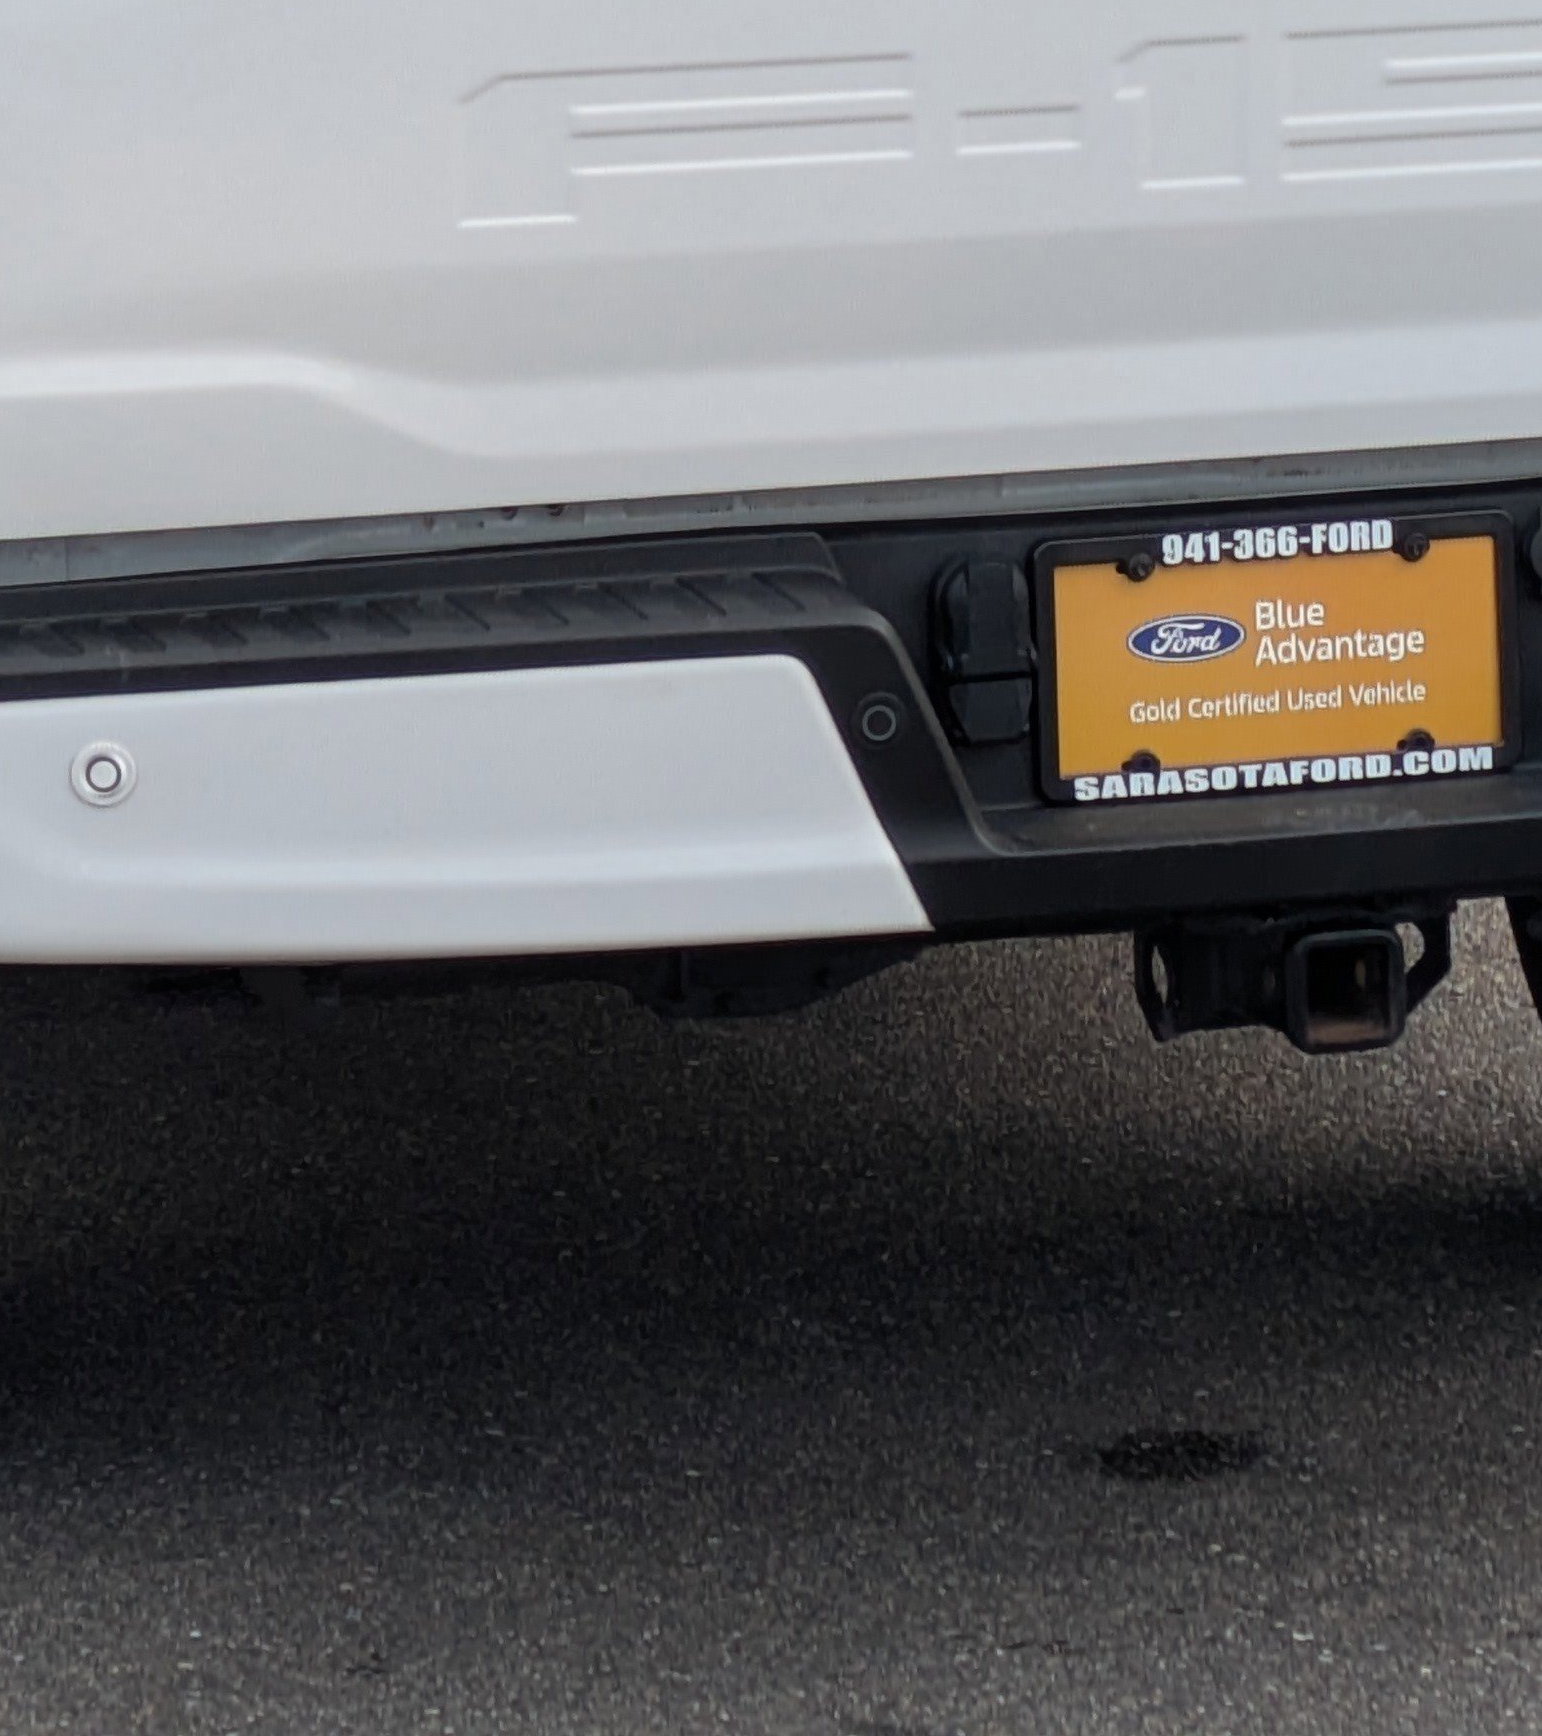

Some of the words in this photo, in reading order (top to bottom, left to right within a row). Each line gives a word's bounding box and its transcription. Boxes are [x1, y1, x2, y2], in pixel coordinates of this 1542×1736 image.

[1161, 519, 1394, 565] 941-366-FORD
[1255, 599, 1325, 631] Blue
[1149, 621, 1223, 655] Ford
[1254, 628, 1425, 667] Advantage
[1129, 697, 1181, 725] Gold
[1187, 689, 1280, 720] Certified
[1287, 685, 1343, 712] Used
[1349, 679, 1427, 708] Vehicle
[1073, 746, 1493, 802] SARASOTAFORD.COM
